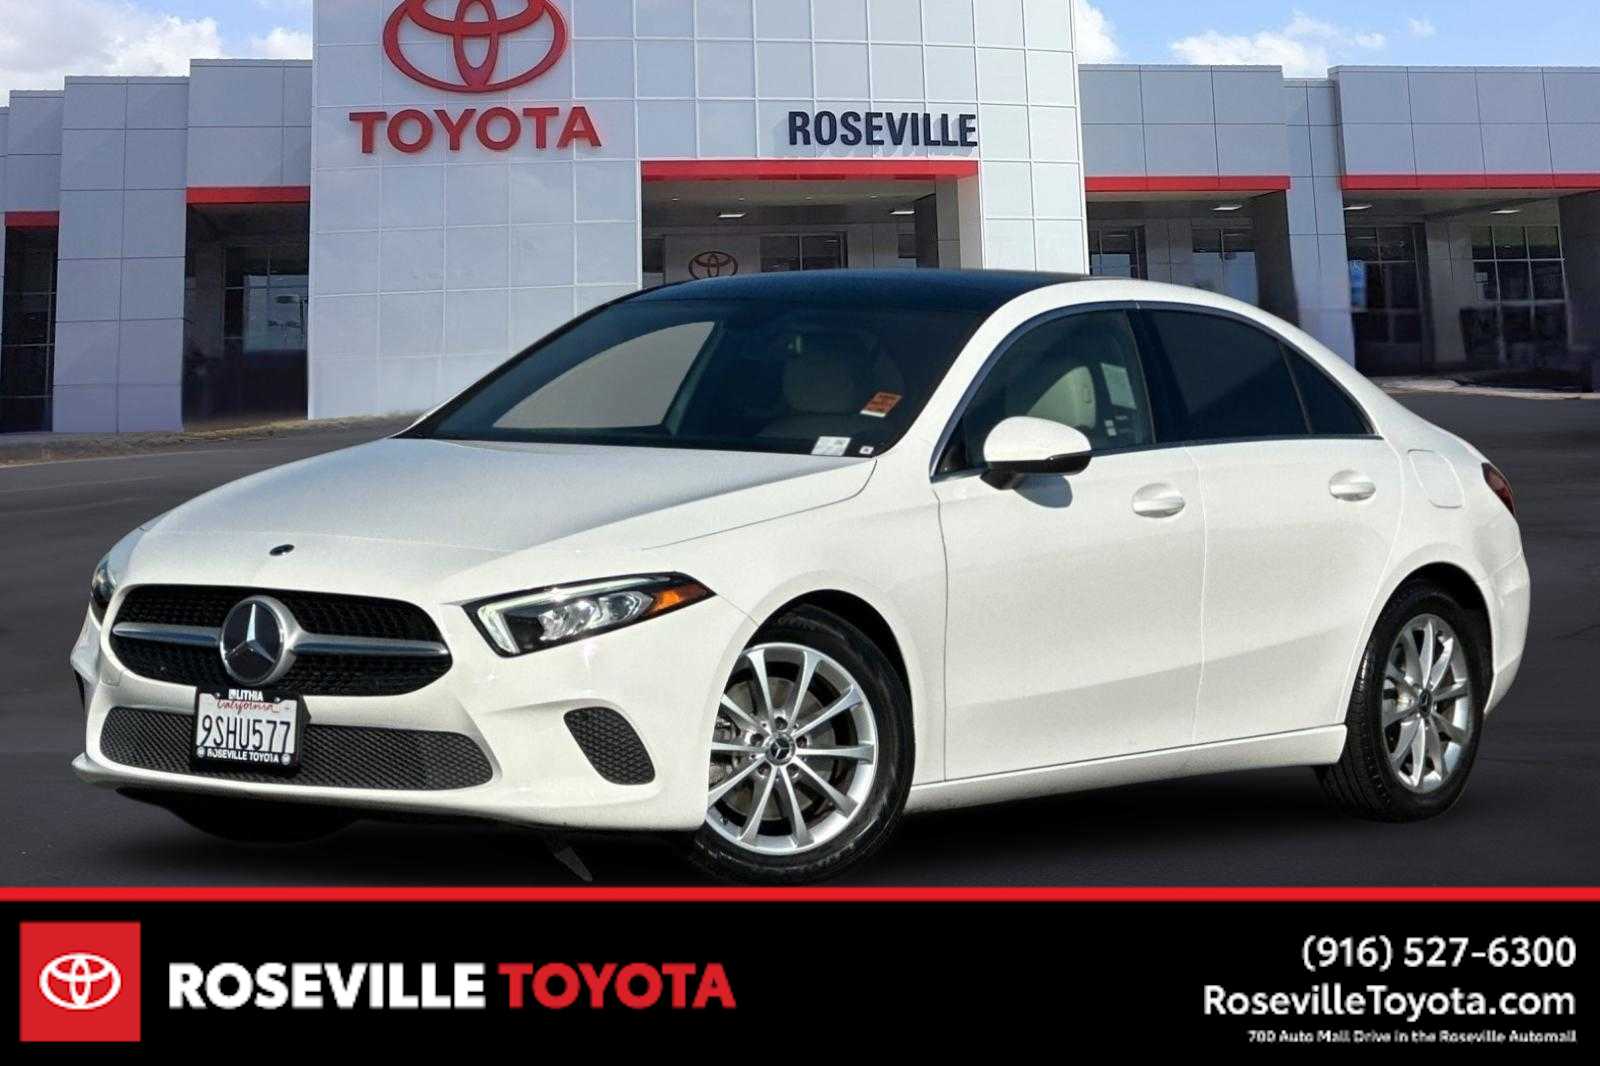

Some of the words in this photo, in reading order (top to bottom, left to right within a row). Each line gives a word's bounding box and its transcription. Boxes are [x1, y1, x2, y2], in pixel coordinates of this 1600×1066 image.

[349, 106, 602, 154] TOYOTA
[788, 111, 978, 147] ROSEVILLE
[200, 714, 290, 754] 9SHU577
[249, 752, 279, 763] TOYOTA
